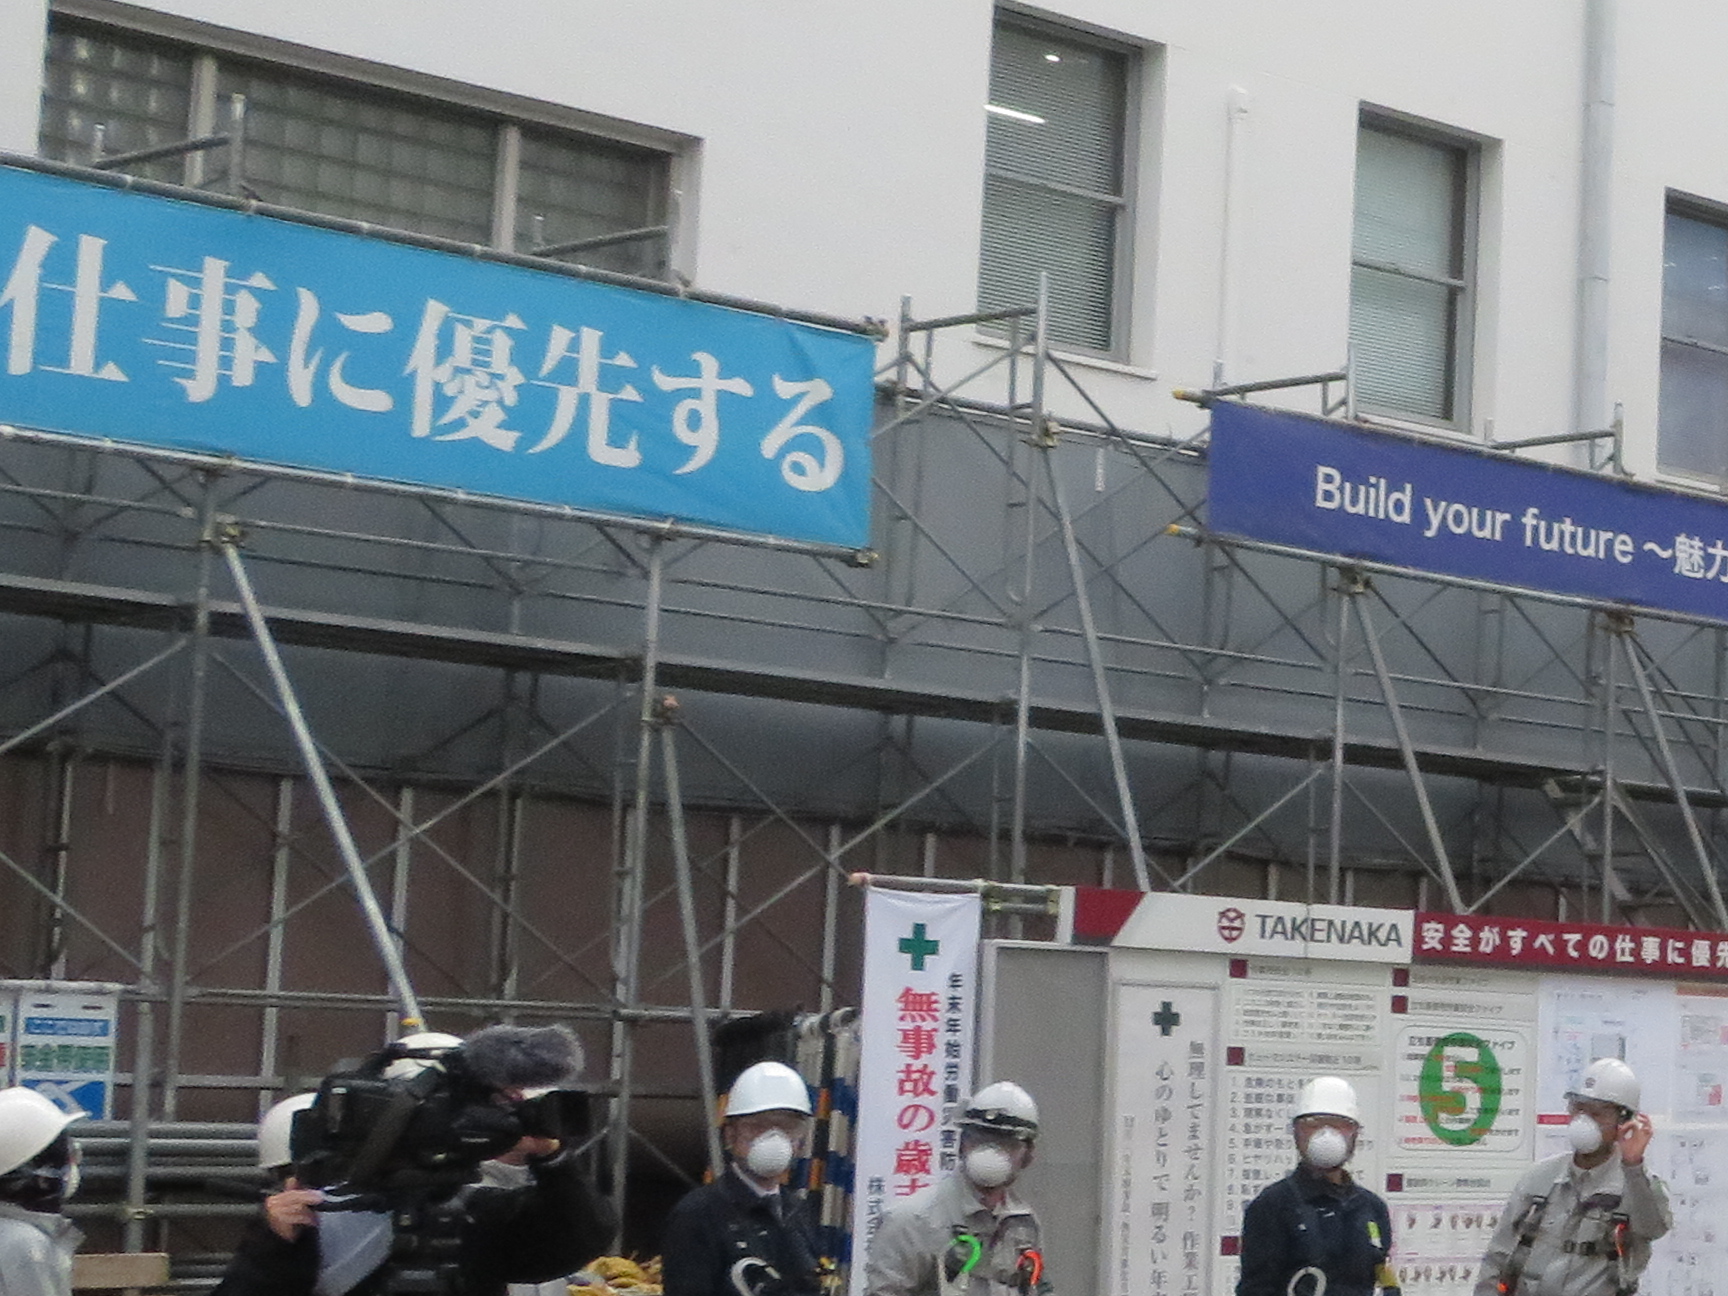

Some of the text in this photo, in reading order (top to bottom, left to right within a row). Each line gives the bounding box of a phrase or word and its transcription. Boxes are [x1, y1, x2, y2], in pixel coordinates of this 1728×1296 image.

[0, 224, 844, 492] 仕事に優先する
[1315, 464, 1411, 524] Build
[1423, 496, 1511, 542] your
[1521, 507, 1634, 565] future
[1255, 913, 1402, 949] TAKENAKA
[1438, 1047, 1482, 1131] 5
